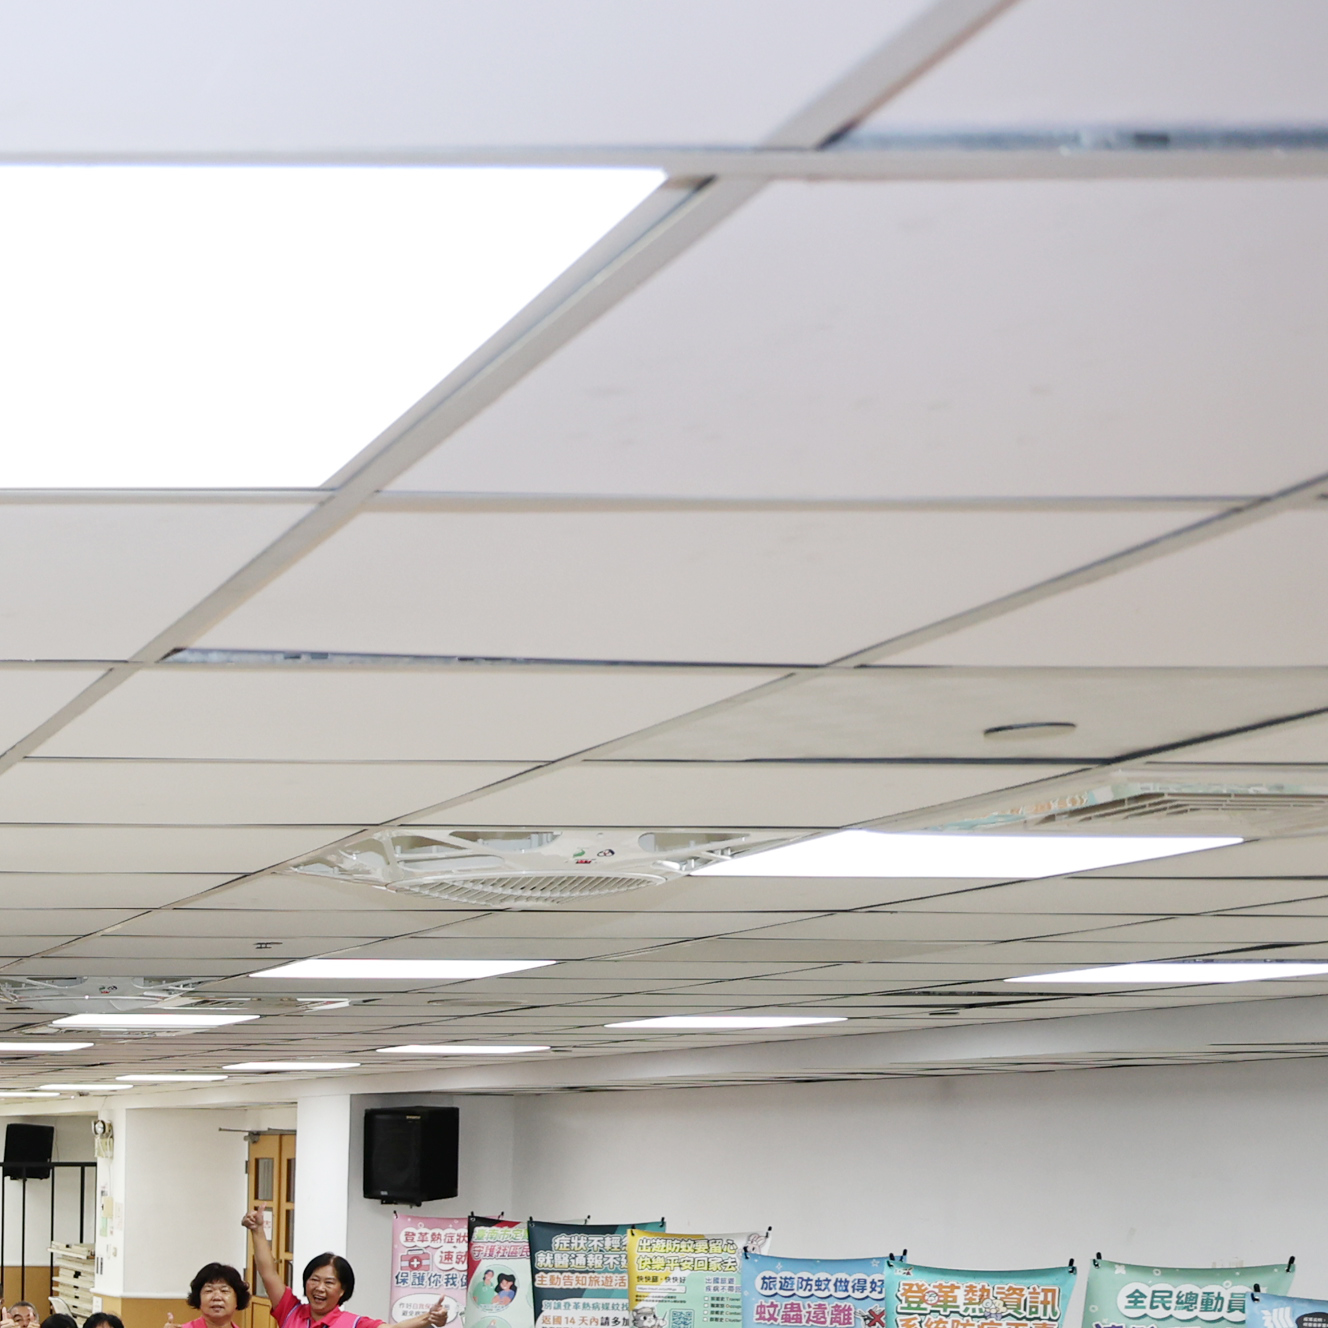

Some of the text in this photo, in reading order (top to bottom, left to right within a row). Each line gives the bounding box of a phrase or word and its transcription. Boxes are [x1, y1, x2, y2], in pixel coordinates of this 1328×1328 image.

[404, 1231, 468, 1244] 登革熱症狀
[637, 1238, 738, 1254] 出遊防蚊要留心
[636, 1255, 738, 1272] 快樂平安回家去
[760, 1275, 885, 1295] 旅遊防蚊做得好
[899, 1281, 1059, 1319] 登革熱資訊
[1124, 1288, 1246, 1314] 全民總動員
[754, 1300, 853, 1326] 蚊蟲遠離
